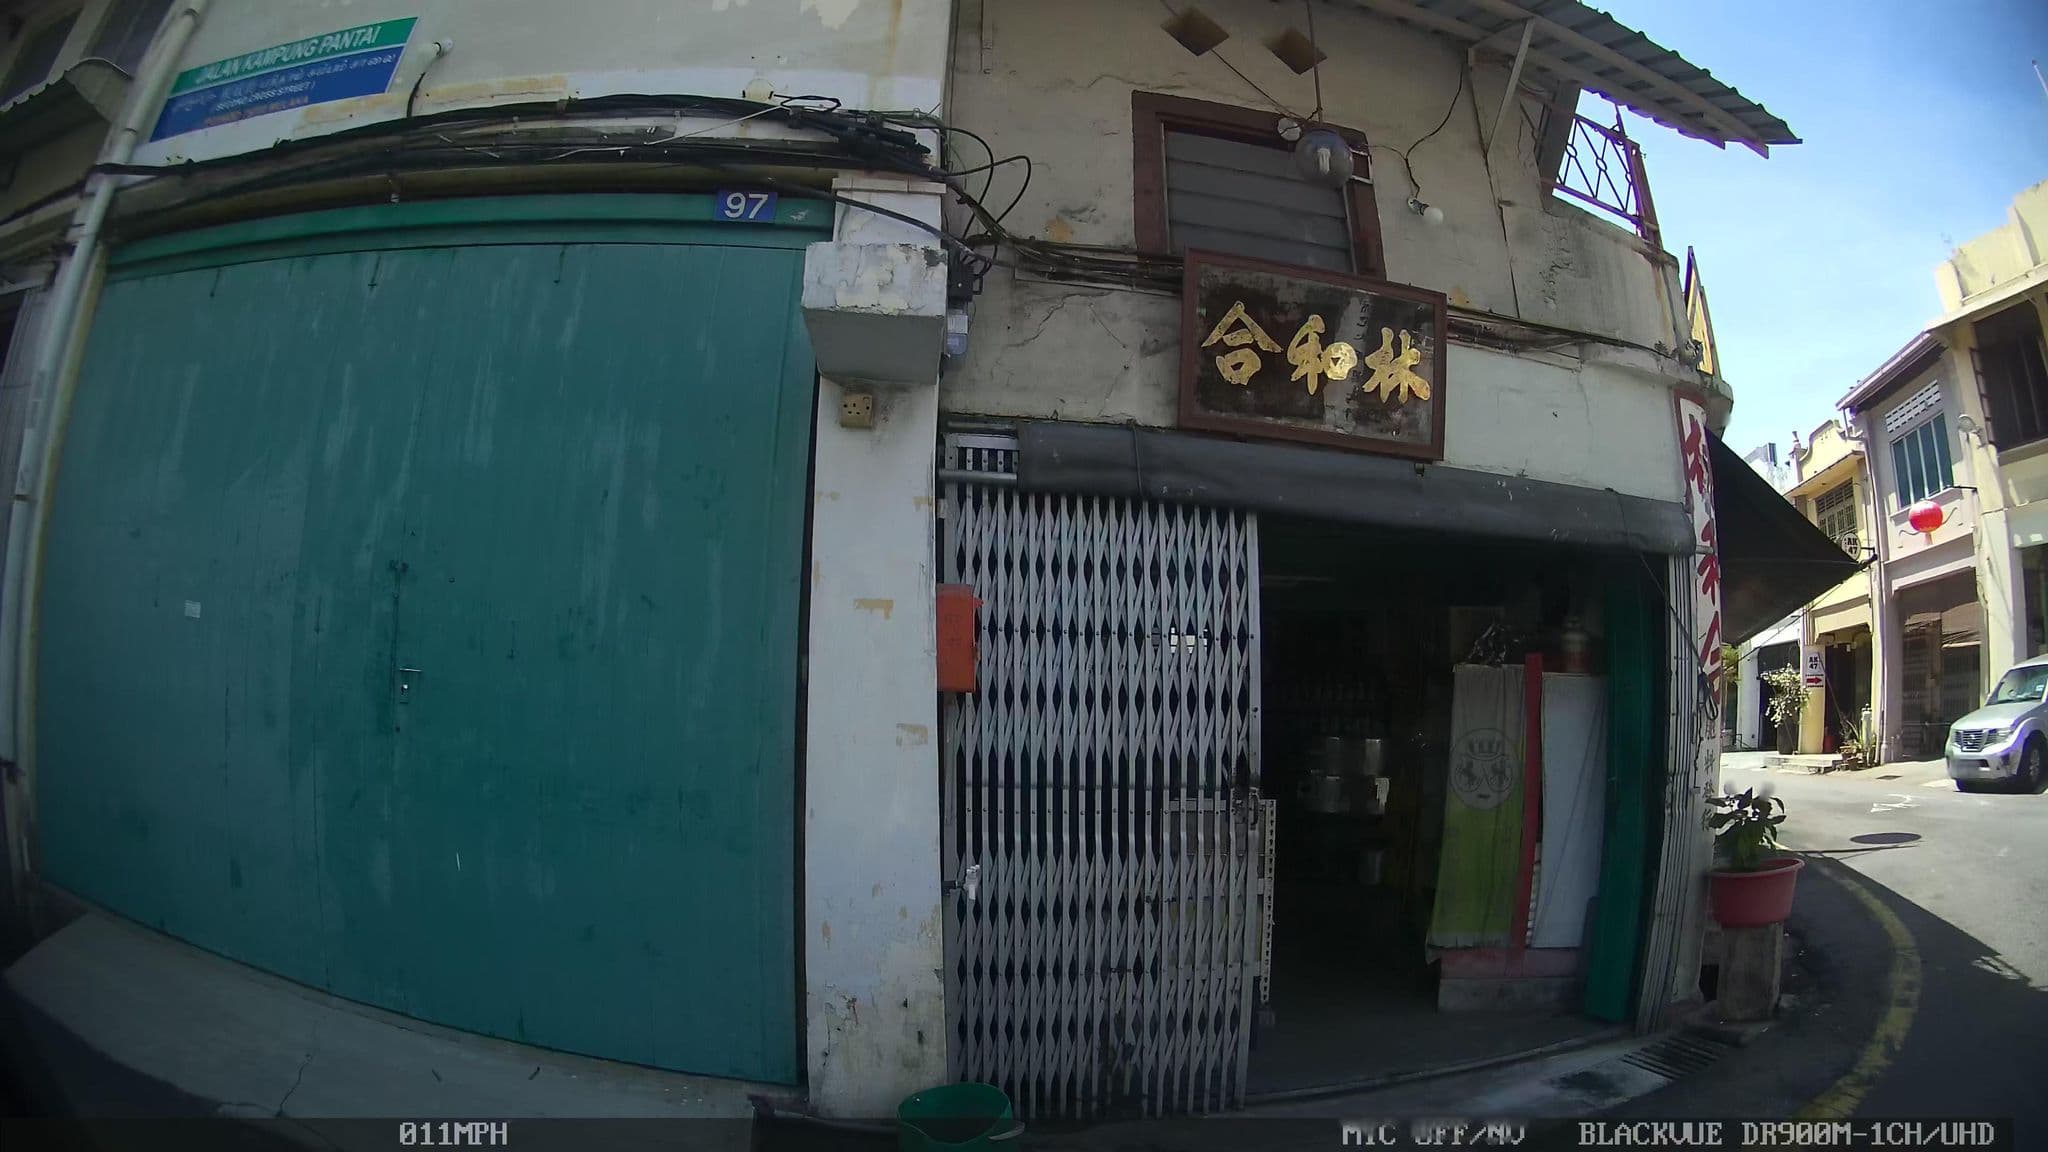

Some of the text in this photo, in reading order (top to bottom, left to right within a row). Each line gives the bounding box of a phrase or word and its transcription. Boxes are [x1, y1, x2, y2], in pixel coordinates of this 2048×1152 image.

[194, 61, 240, 85] JALAN
[239, 40, 319, 73] KAMPUNG
[317, 25, 381, 58] PANTAI
[724, 191, 770, 220] 97
